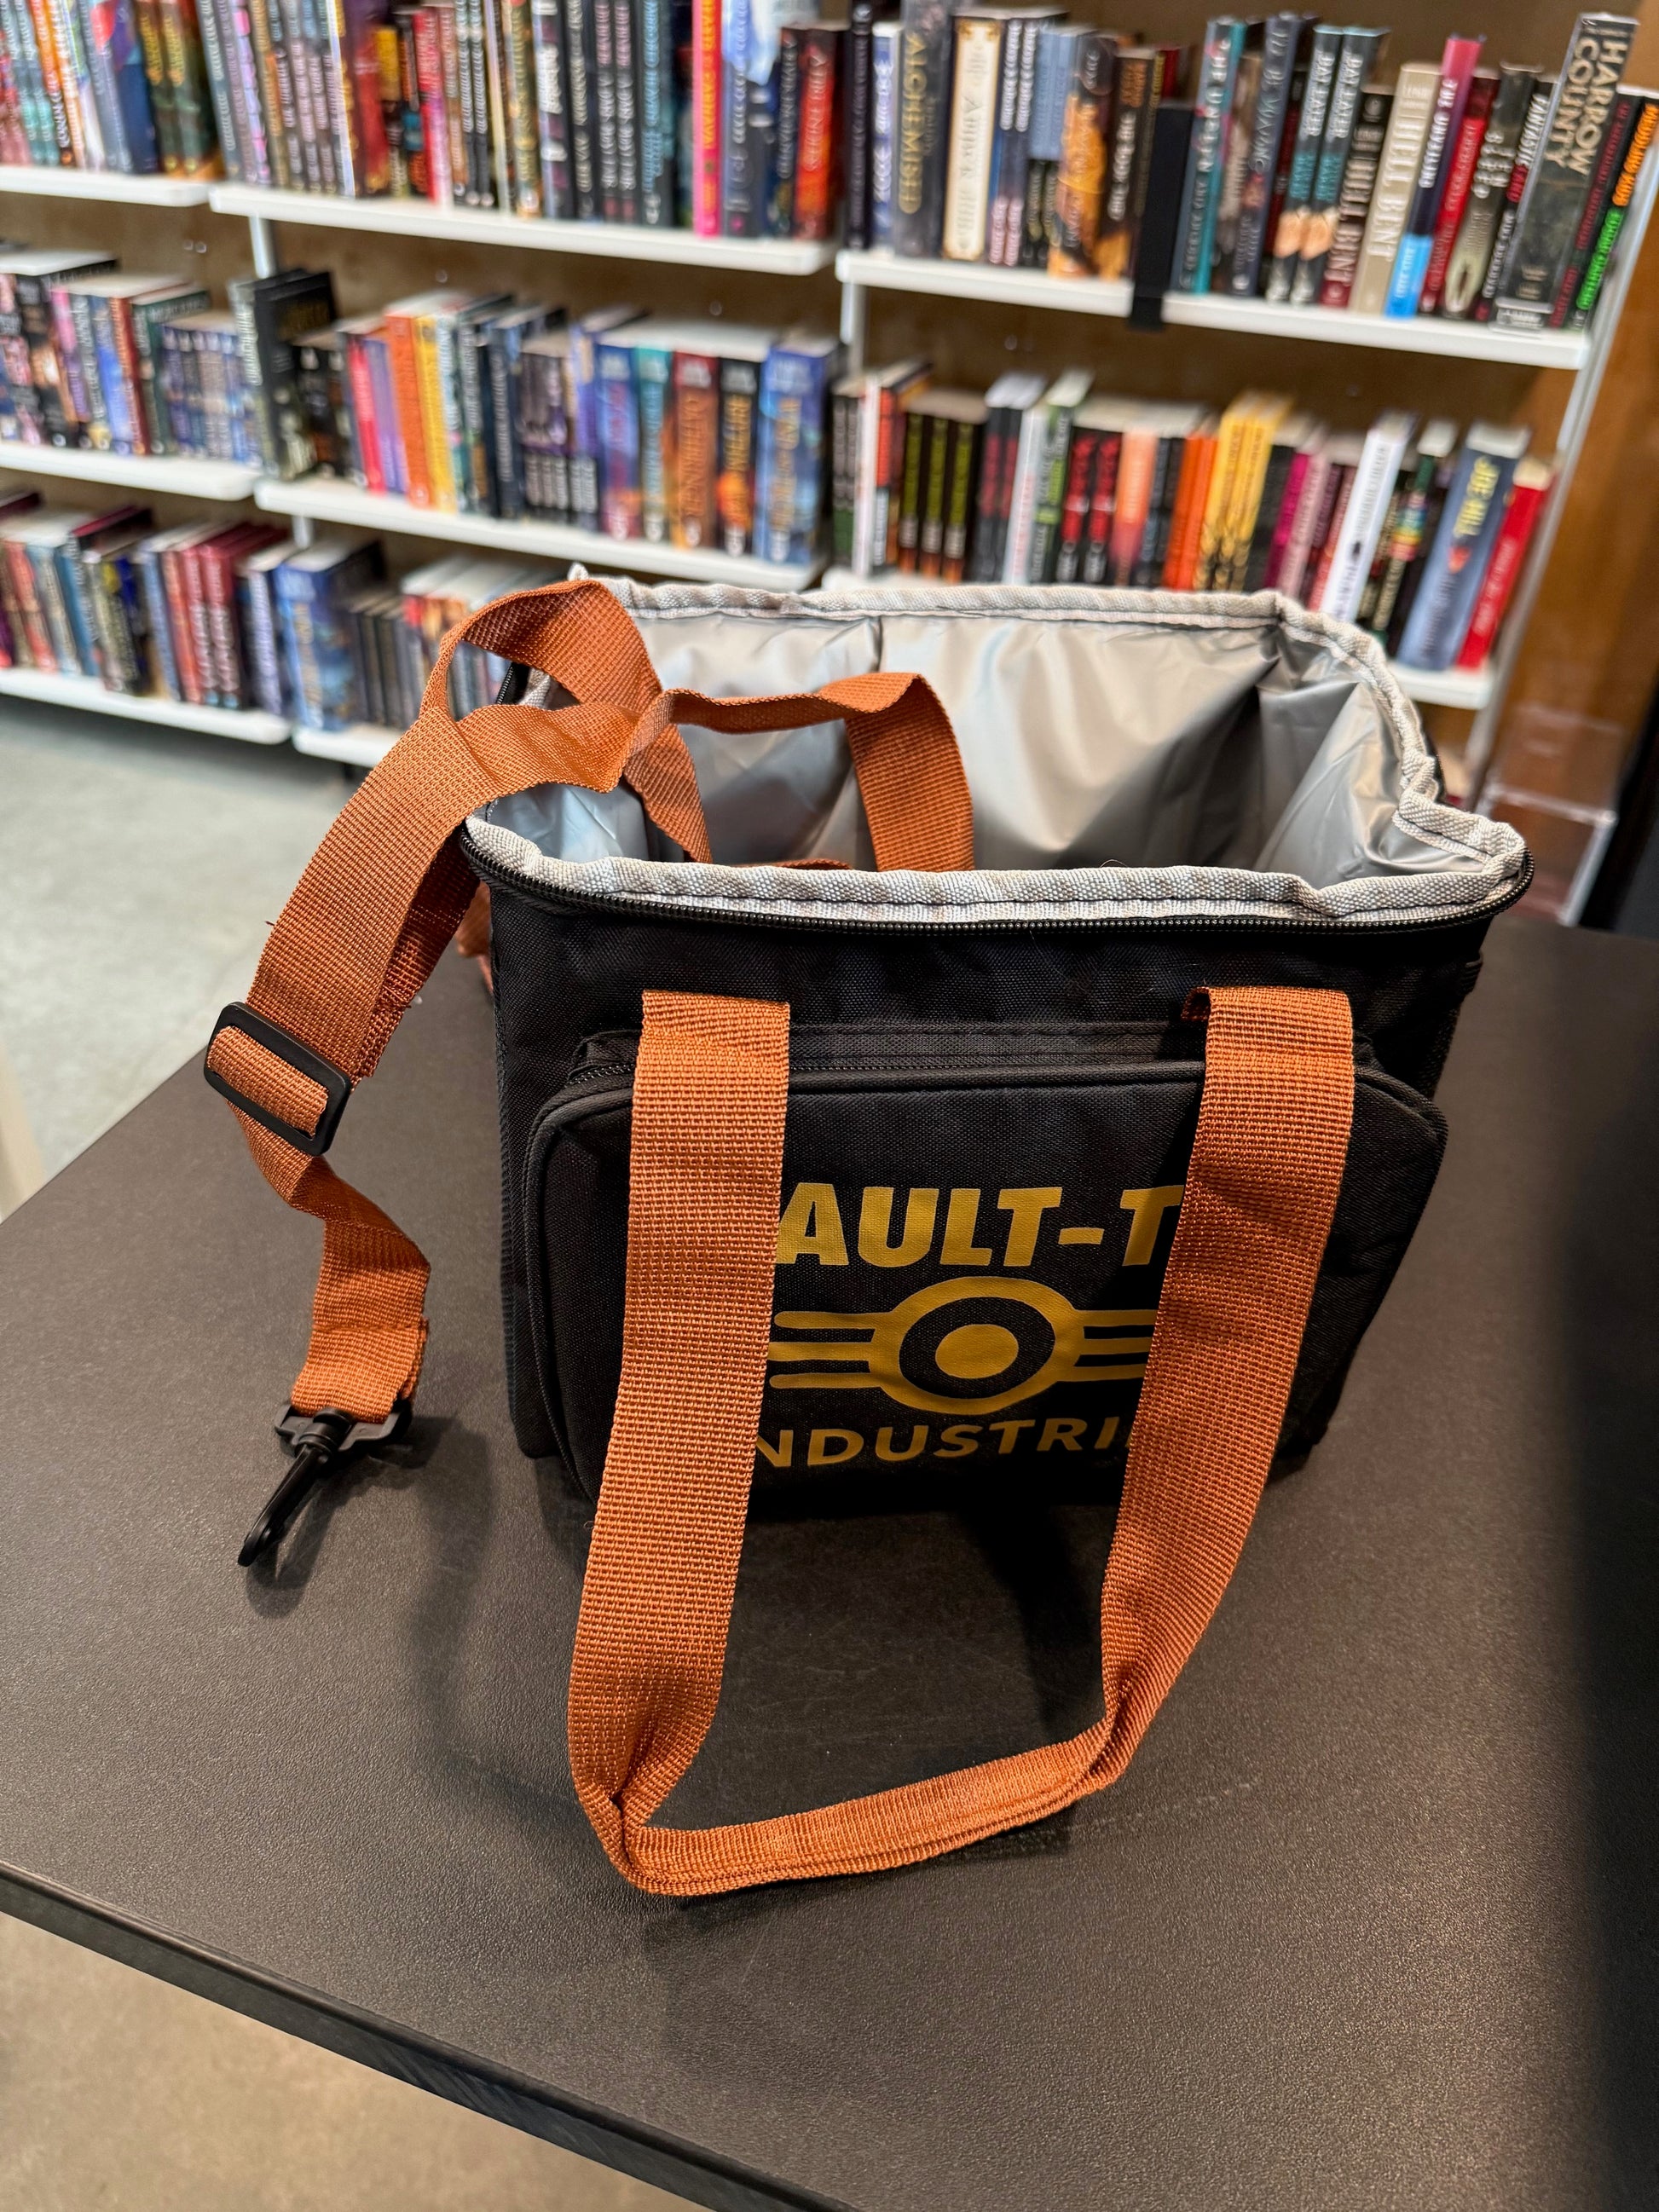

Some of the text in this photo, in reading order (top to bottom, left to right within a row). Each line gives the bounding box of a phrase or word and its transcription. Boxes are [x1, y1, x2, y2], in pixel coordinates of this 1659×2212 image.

[1543, 37, 1600, 168] COUNTY
[1566, 39, 1629, 176] HARROW
[1381, 118, 1427, 187] HELL
[1366, 190, 1408, 261] BENT
[775, 1181, 1184, 1268] AULT-T
[755, 1417, 1130, 1468] NDUSTRI
